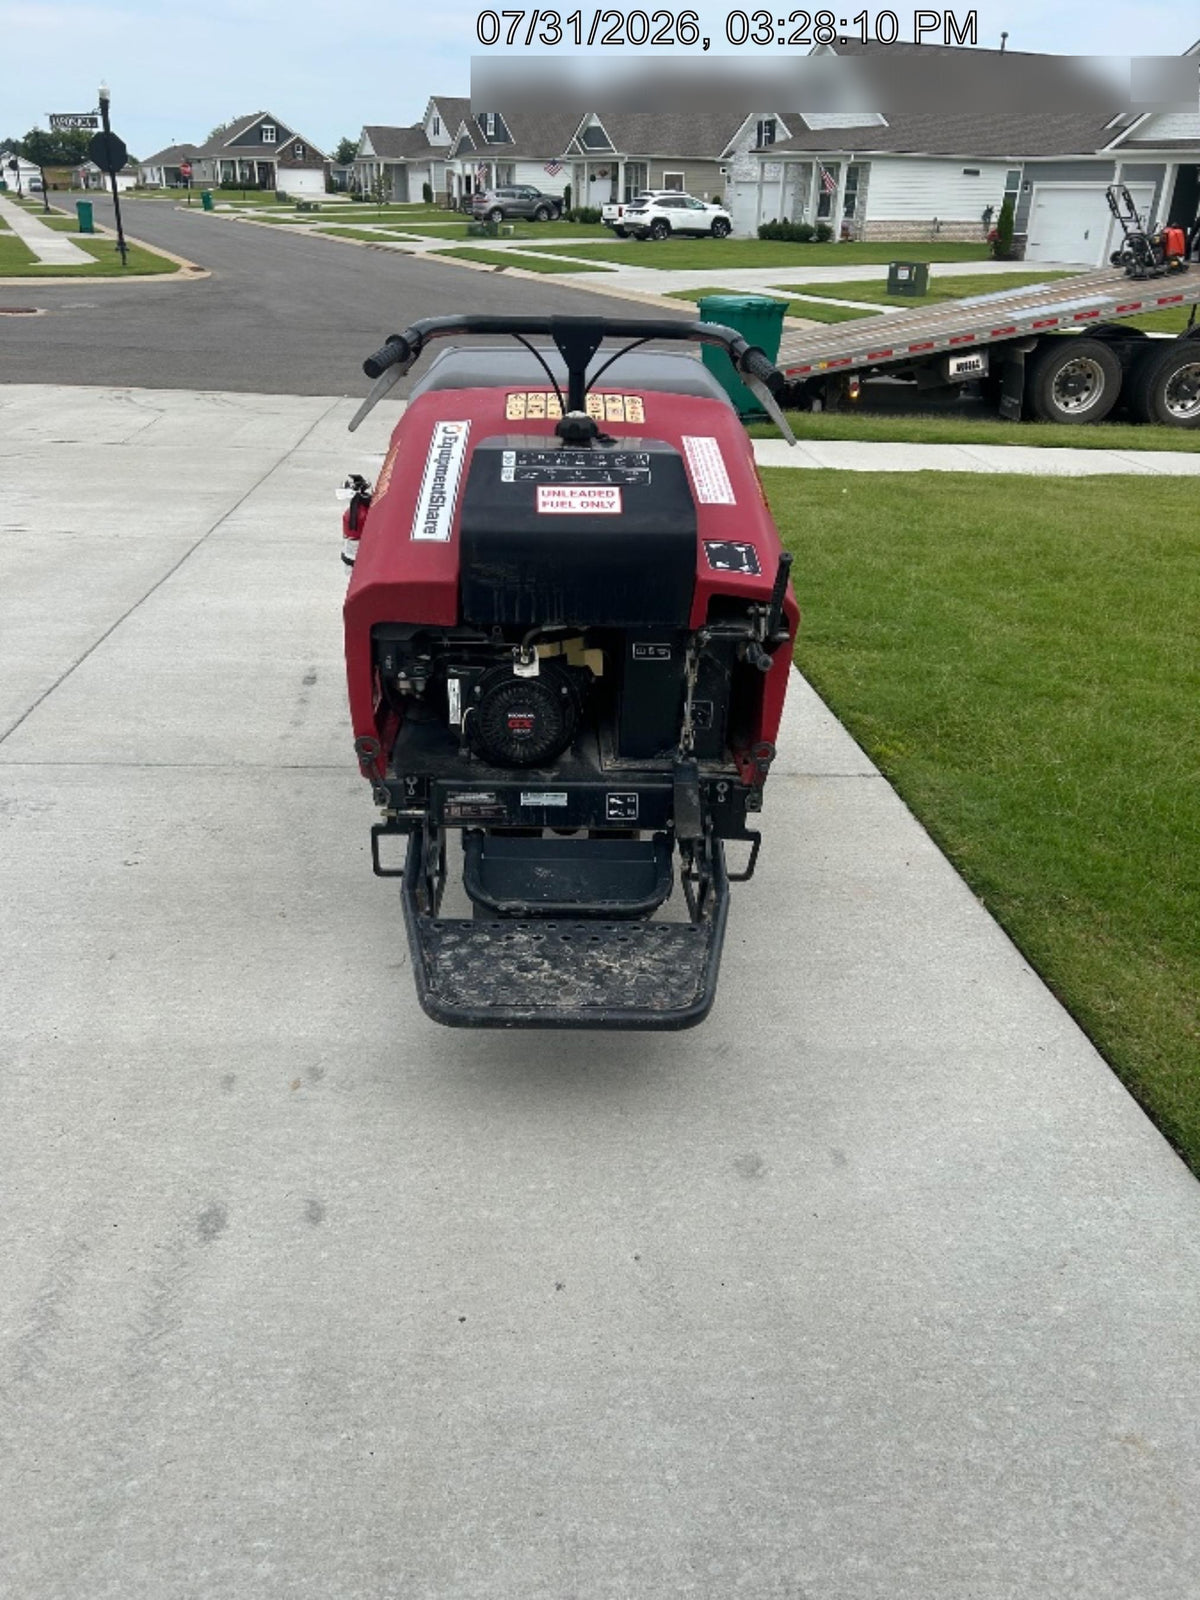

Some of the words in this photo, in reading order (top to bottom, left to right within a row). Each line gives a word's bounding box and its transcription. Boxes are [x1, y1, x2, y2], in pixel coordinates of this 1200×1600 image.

[423, 435, 459, 535] EquipmentShare
[541, 490, 615, 498] UNLEADED
[541, 501, 576, 509] FUEL
[580, 501, 616, 509] ONLY
